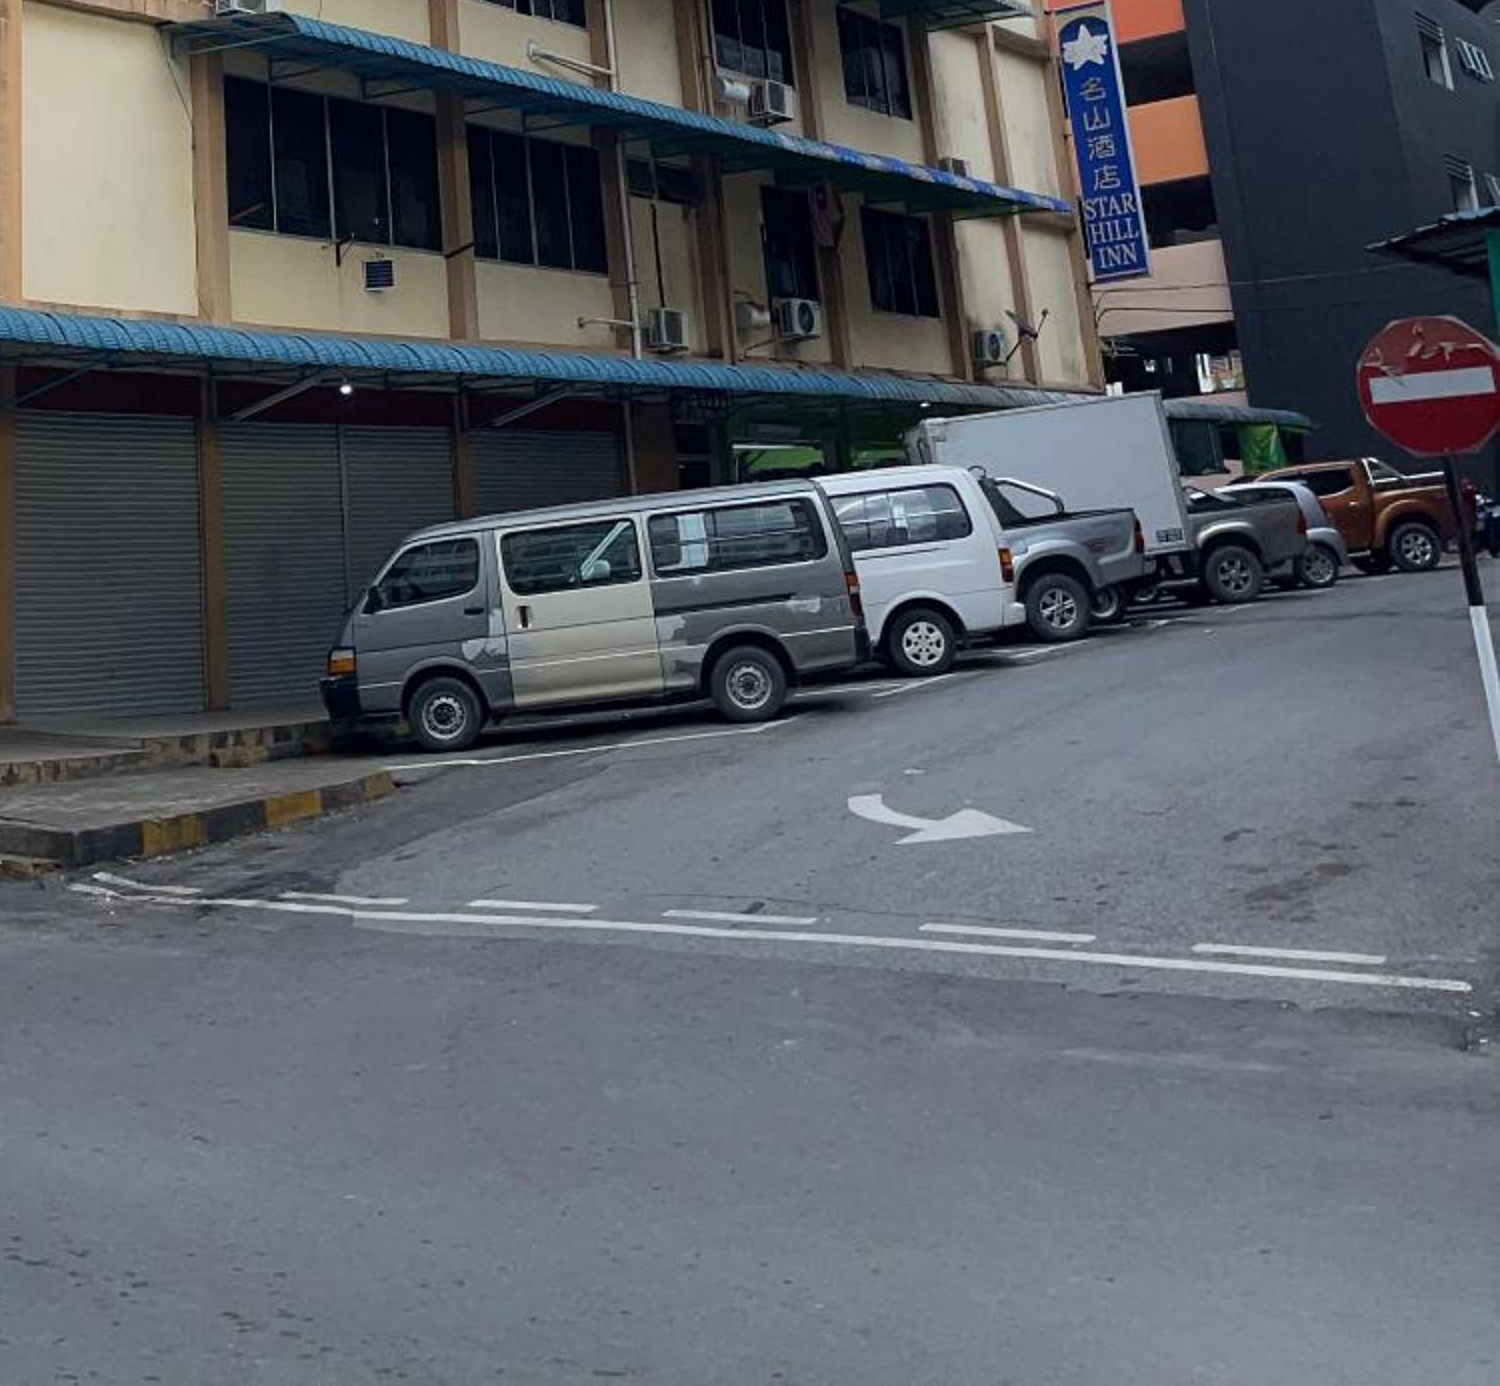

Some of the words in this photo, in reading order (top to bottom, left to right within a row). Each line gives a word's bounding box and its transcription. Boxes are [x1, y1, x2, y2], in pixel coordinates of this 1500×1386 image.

[1079, 77, 1121, 191] 名山酒店
[1084, 193, 1137, 221] STAR
[1090, 217, 1140, 245] HILL
[1095, 242, 1138, 270] INN
